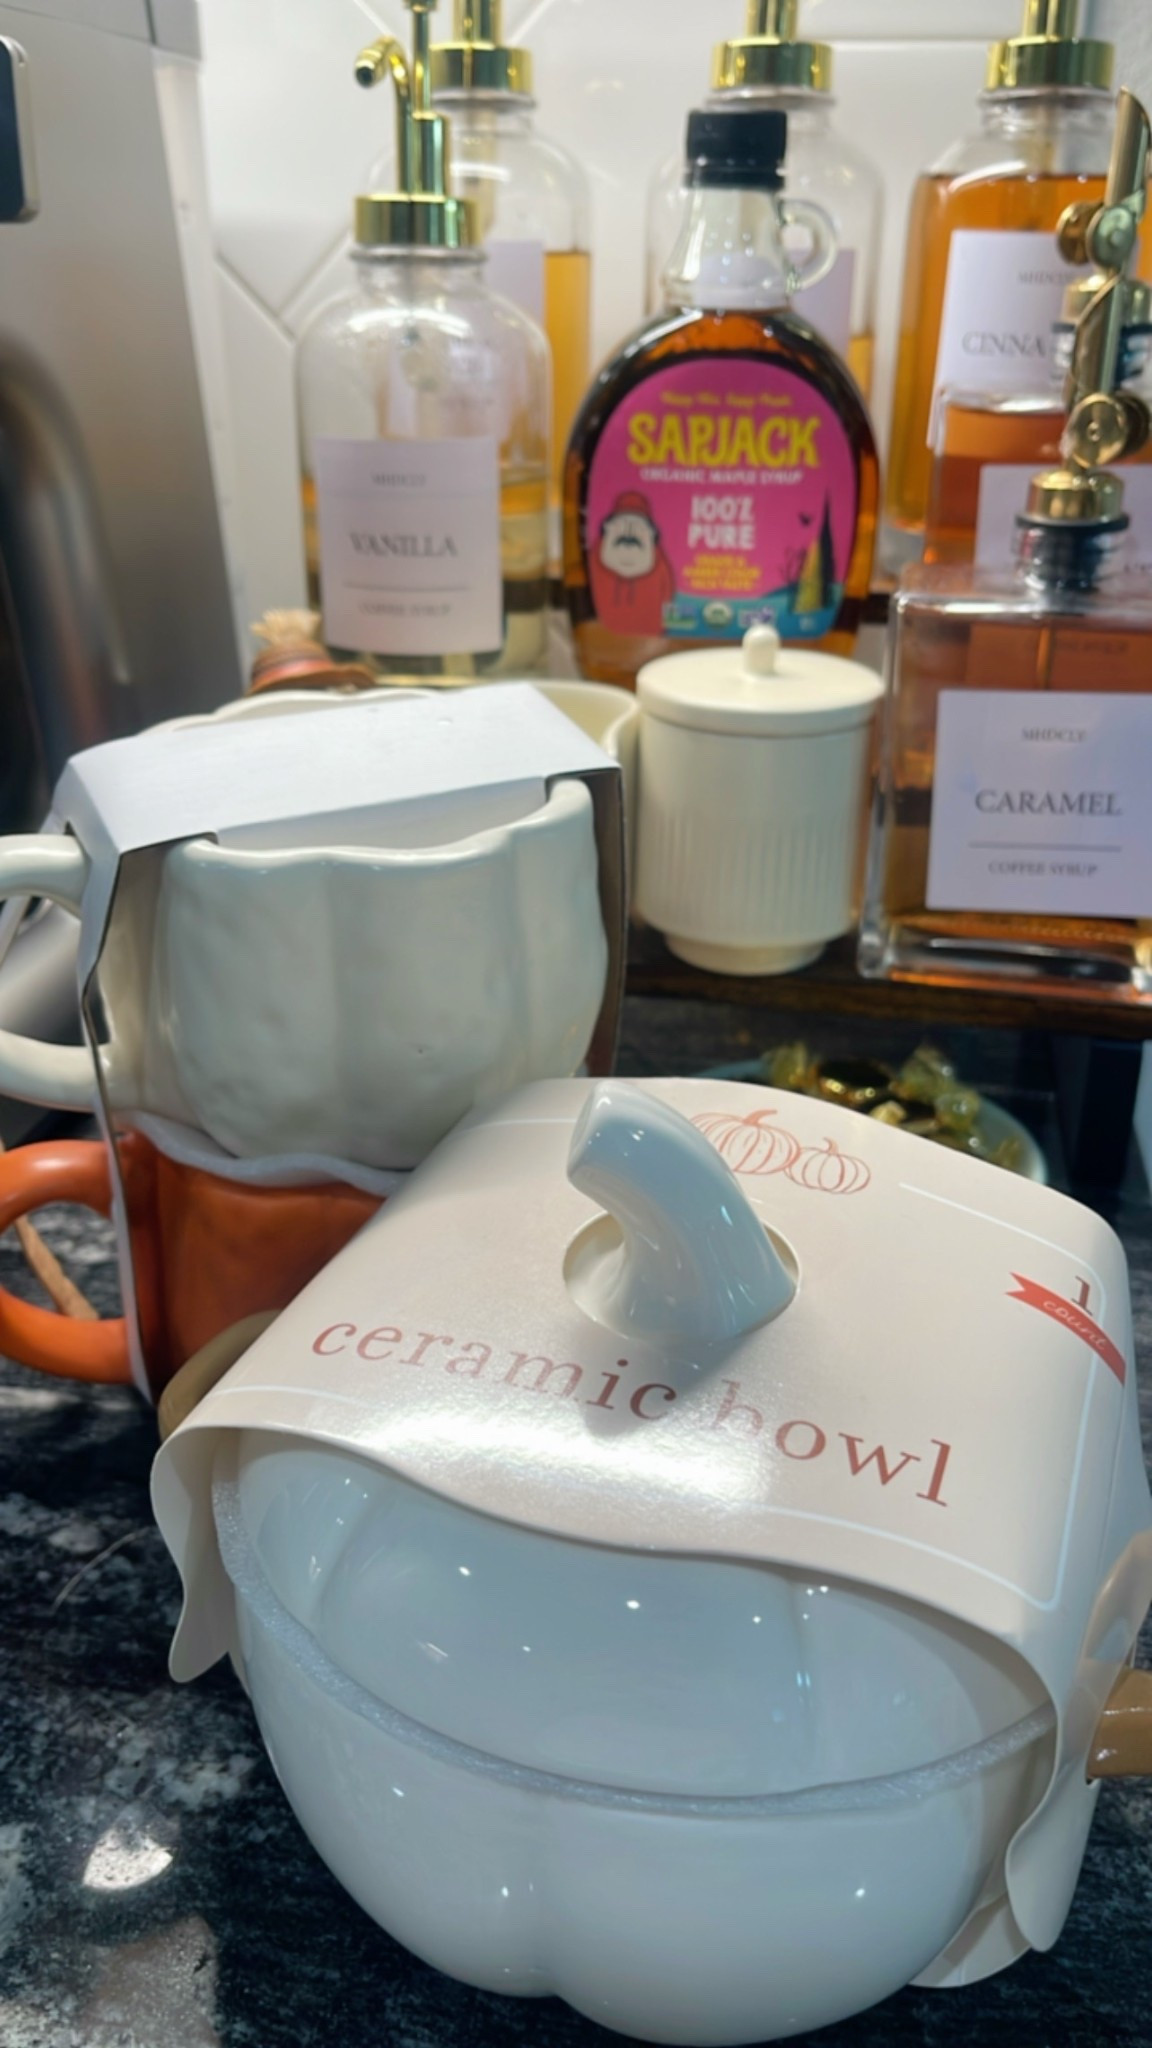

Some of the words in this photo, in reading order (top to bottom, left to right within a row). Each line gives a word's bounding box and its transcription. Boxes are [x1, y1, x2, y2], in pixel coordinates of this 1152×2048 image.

[961, 330, 1047, 357] CINNA
[626, 413, 821, 467] SAPJACK
[710, 468, 756, 484] MAPLE
[760, 468, 804, 485] SYRUP
[350, 532, 459, 557] VANILLA
[688, 523, 755, 549] PURE
[974, 789, 1123, 816] CARAMEL
[987, 860, 1045, 876] COFFEE
[1049, 862, 1098, 878] SYRUP
[1070, 1275, 1093, 1316] 1
[1043, 1301, 1106, 1350] count
[312, 1321, 679, 1421] ceramic
[716, 1378, 952, 1507] bowl
